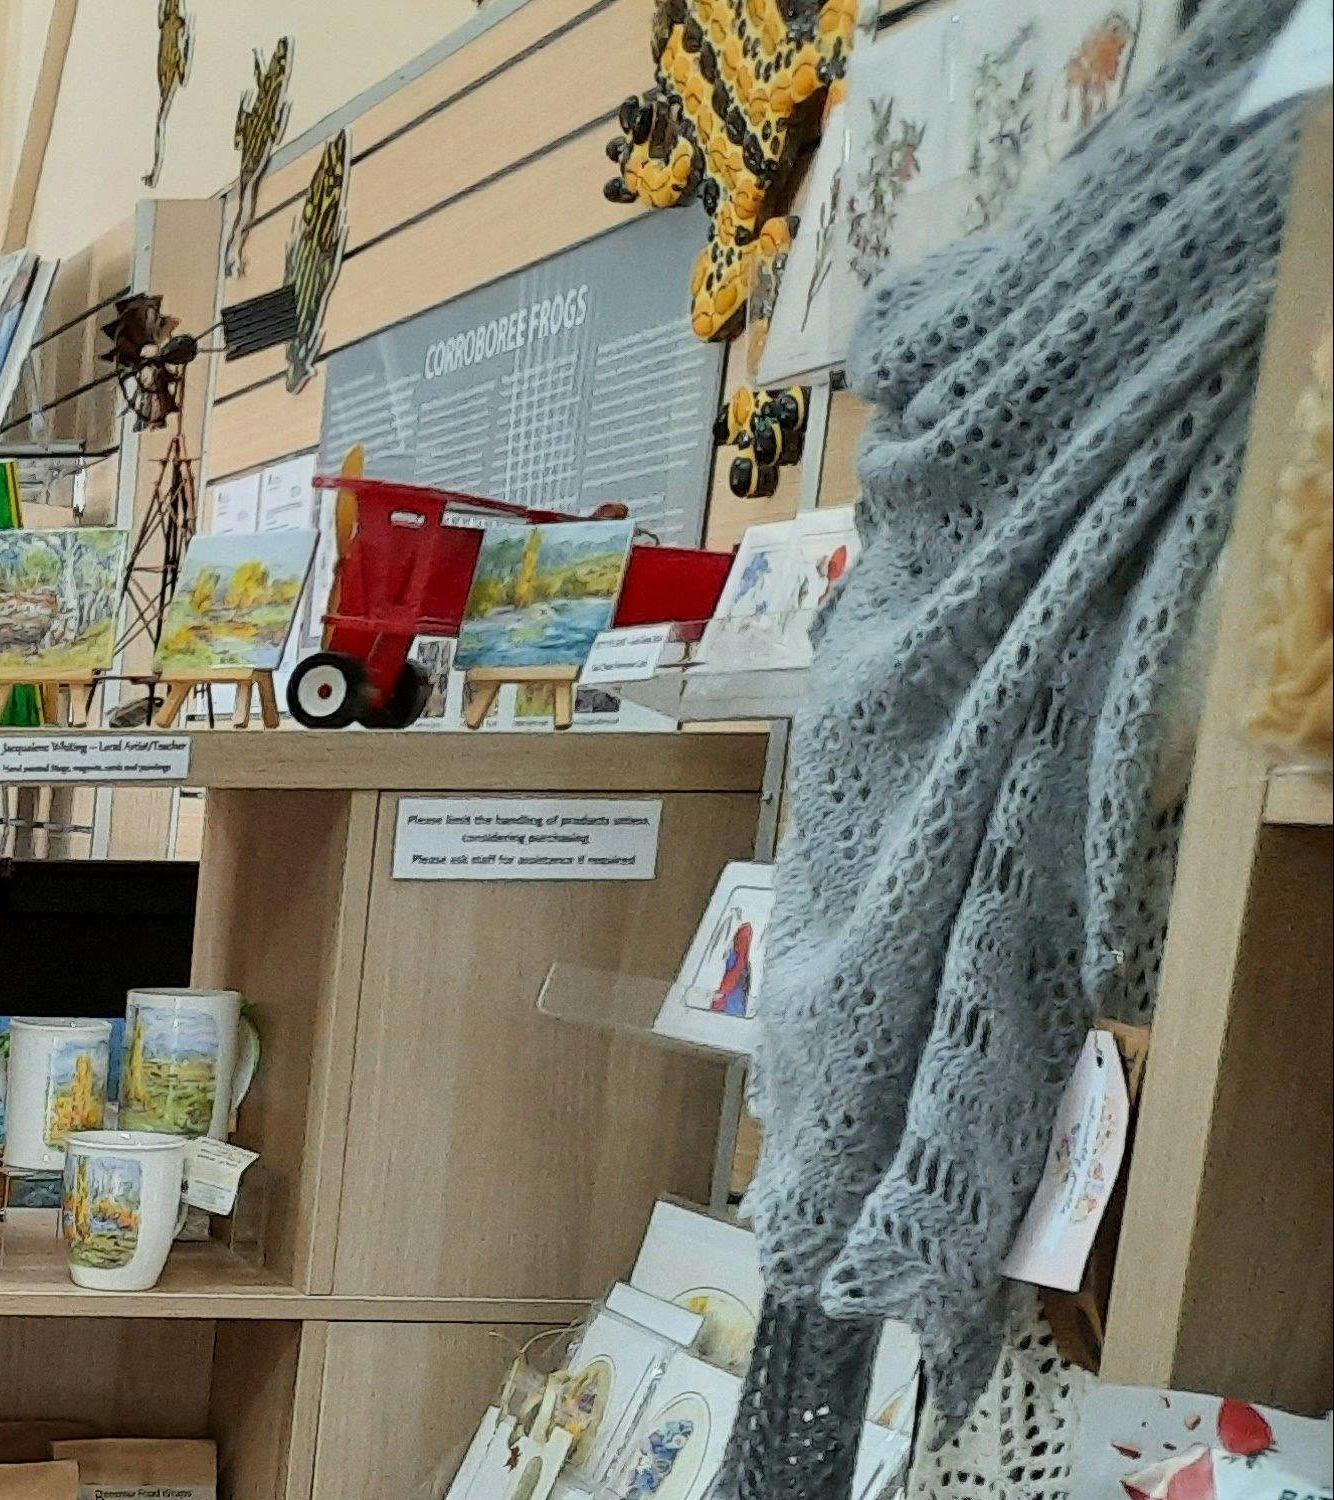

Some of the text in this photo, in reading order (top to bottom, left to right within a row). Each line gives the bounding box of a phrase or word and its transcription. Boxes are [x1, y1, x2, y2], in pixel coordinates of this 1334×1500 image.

[423, 284, 589, 380] CORROBOREE FROGS
[98, 740, 122, 752] Local
[407, 815, 443, 826] Please
[445, 814, 472, 825] limit
[474, 815, 493, 825] the
[494, 814, 544, 828] handling
[545, 815, 559, 826] of
[560, 815, 610, 827] products
[461, 833, 590, 845] considering purchasing
[412, 854, 447, 864] Please
[471, 854, 497, 865] staff
[497, 855, 515, 865] for
[517, 855, 574, 865] assistance
[587, 855, 637, 866] required
